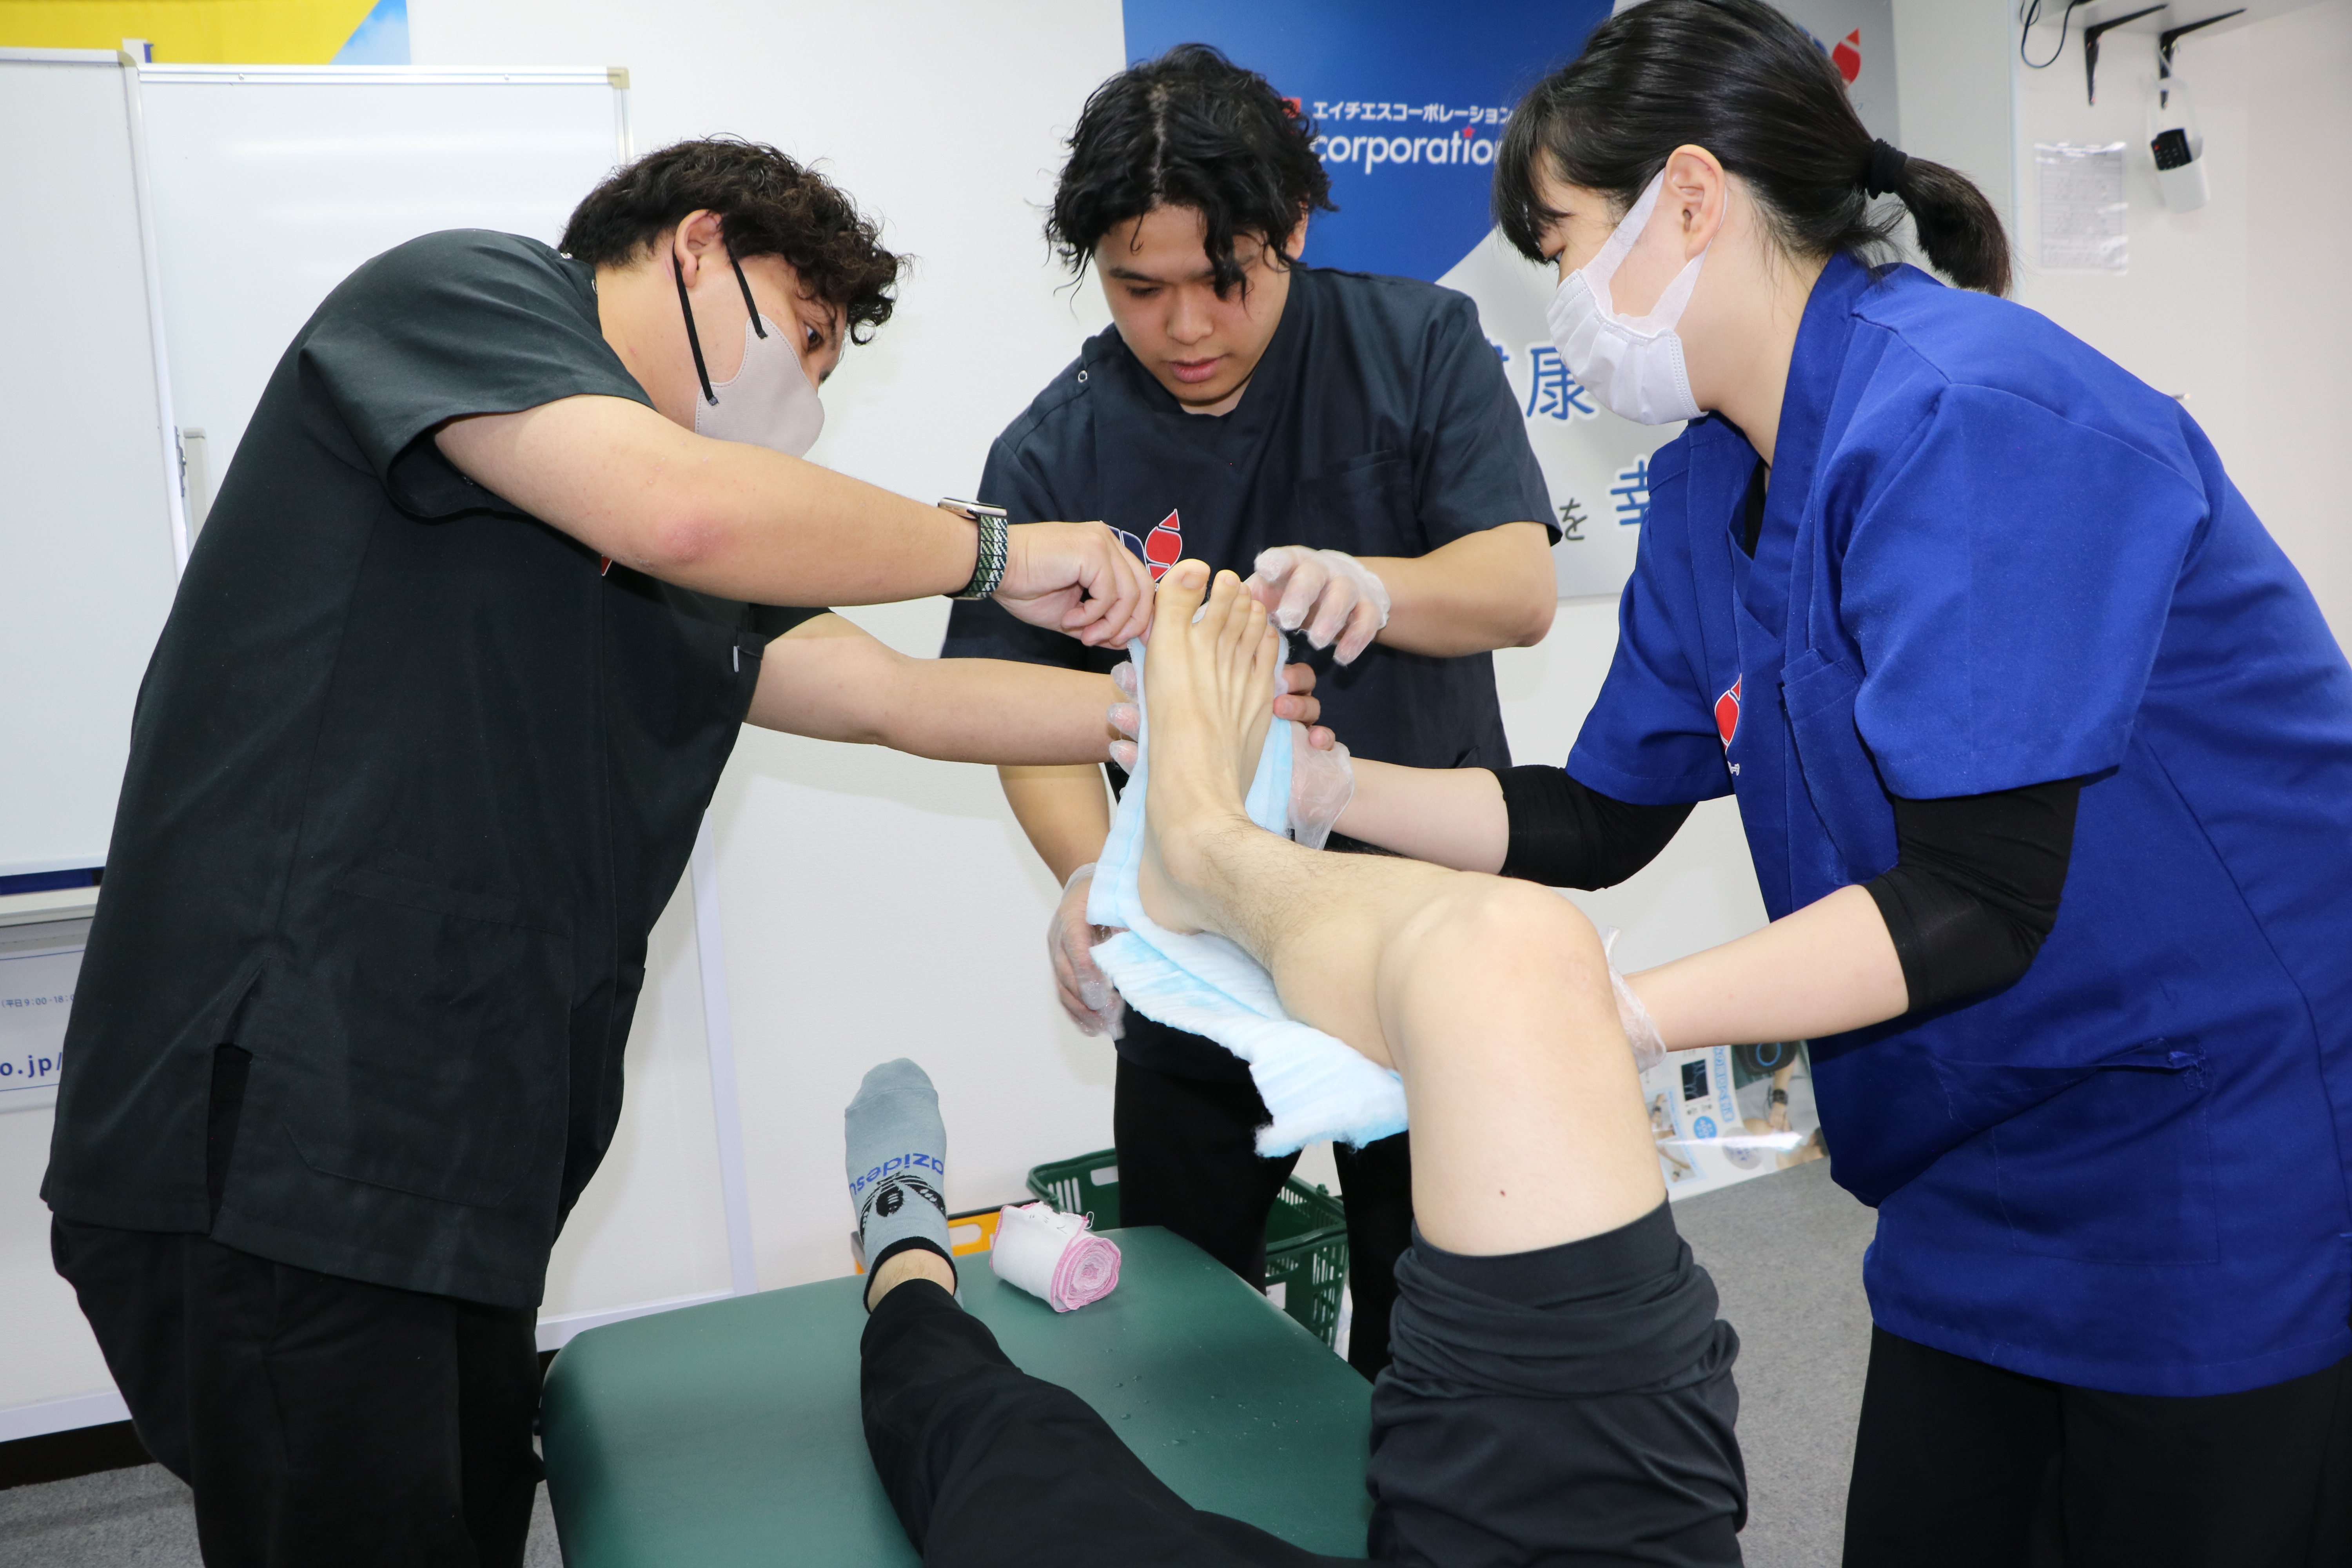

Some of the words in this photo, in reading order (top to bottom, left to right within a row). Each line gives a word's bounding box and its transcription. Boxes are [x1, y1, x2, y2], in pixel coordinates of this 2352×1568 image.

[1313, 102, 1514, 124] エイチエスコーポレーション
[1488, 339, 1594, 419] 康
